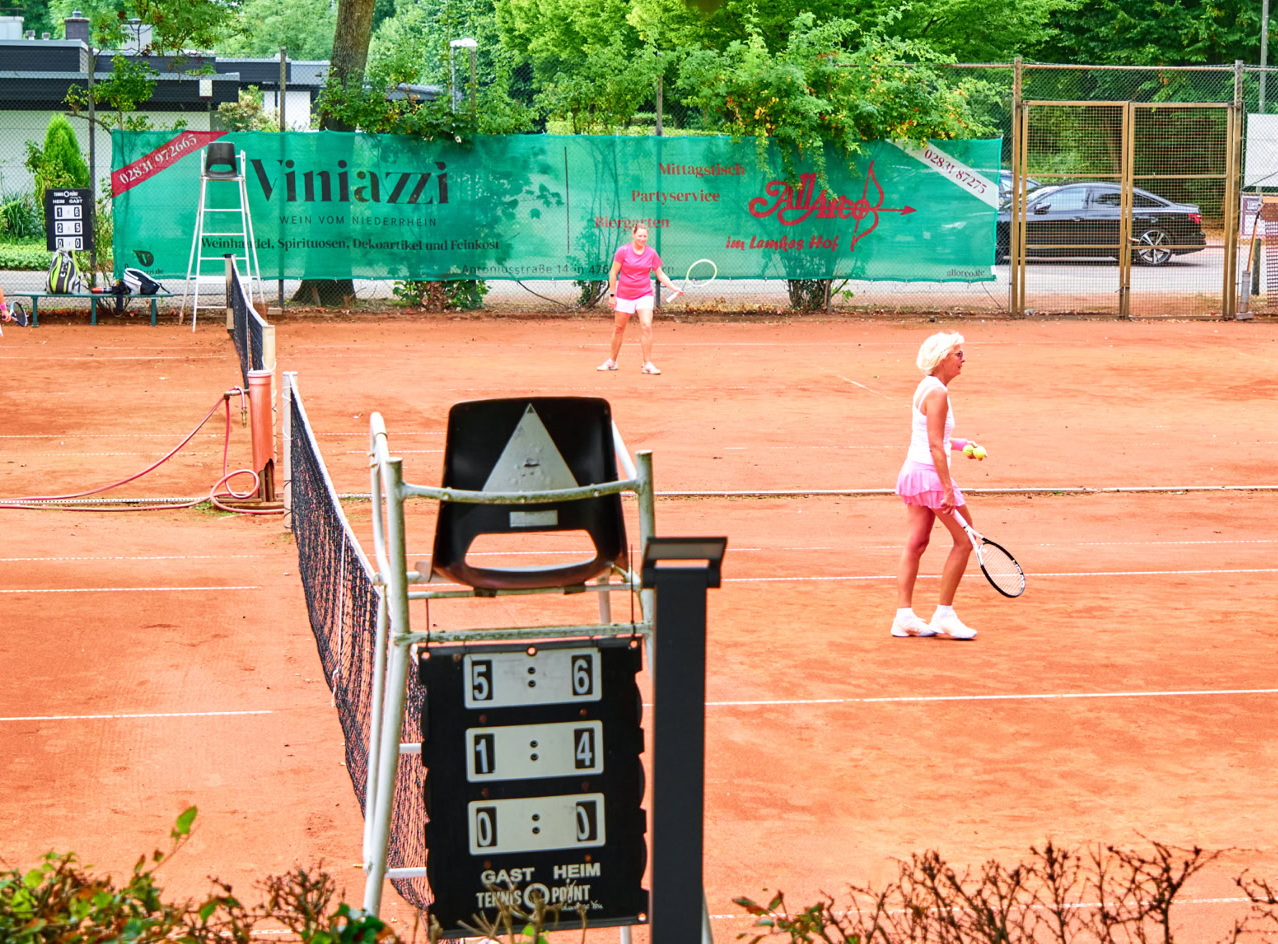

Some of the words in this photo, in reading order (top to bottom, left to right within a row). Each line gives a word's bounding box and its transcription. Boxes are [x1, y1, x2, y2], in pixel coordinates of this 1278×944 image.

[658, 163, 745, 179] Mittagstisch
[250, 159, 449, 205] Viniazzi
[632, 190, 720, 205] Partyservice
[57, 223, 63, 233] 2
[279, 215, 312, 225] WEIN
[318, 215, 345, 225] VOM
[352, 216, 437, 227] NIEDERRHEIN
[277, 238, 350, 252] Spirituosen,
[353, 238, 423, 250] Dekoartikel
[425, 240, 448, 250] und
[451, 239, 499, 250] Feinkost
[726, 235, 745, 251] im
[808, 235, 839, 252] Hof
[472, 664, 490, 701] 5
[573, 658, 590, 695] 6
[474, 737, 489, 774] 1
[576, 731, 592, 767] 4
[477, 811, 492, 847] 0
[481, 867, 535, 884] GAST
[553, 863, 601, 879] HEIM
